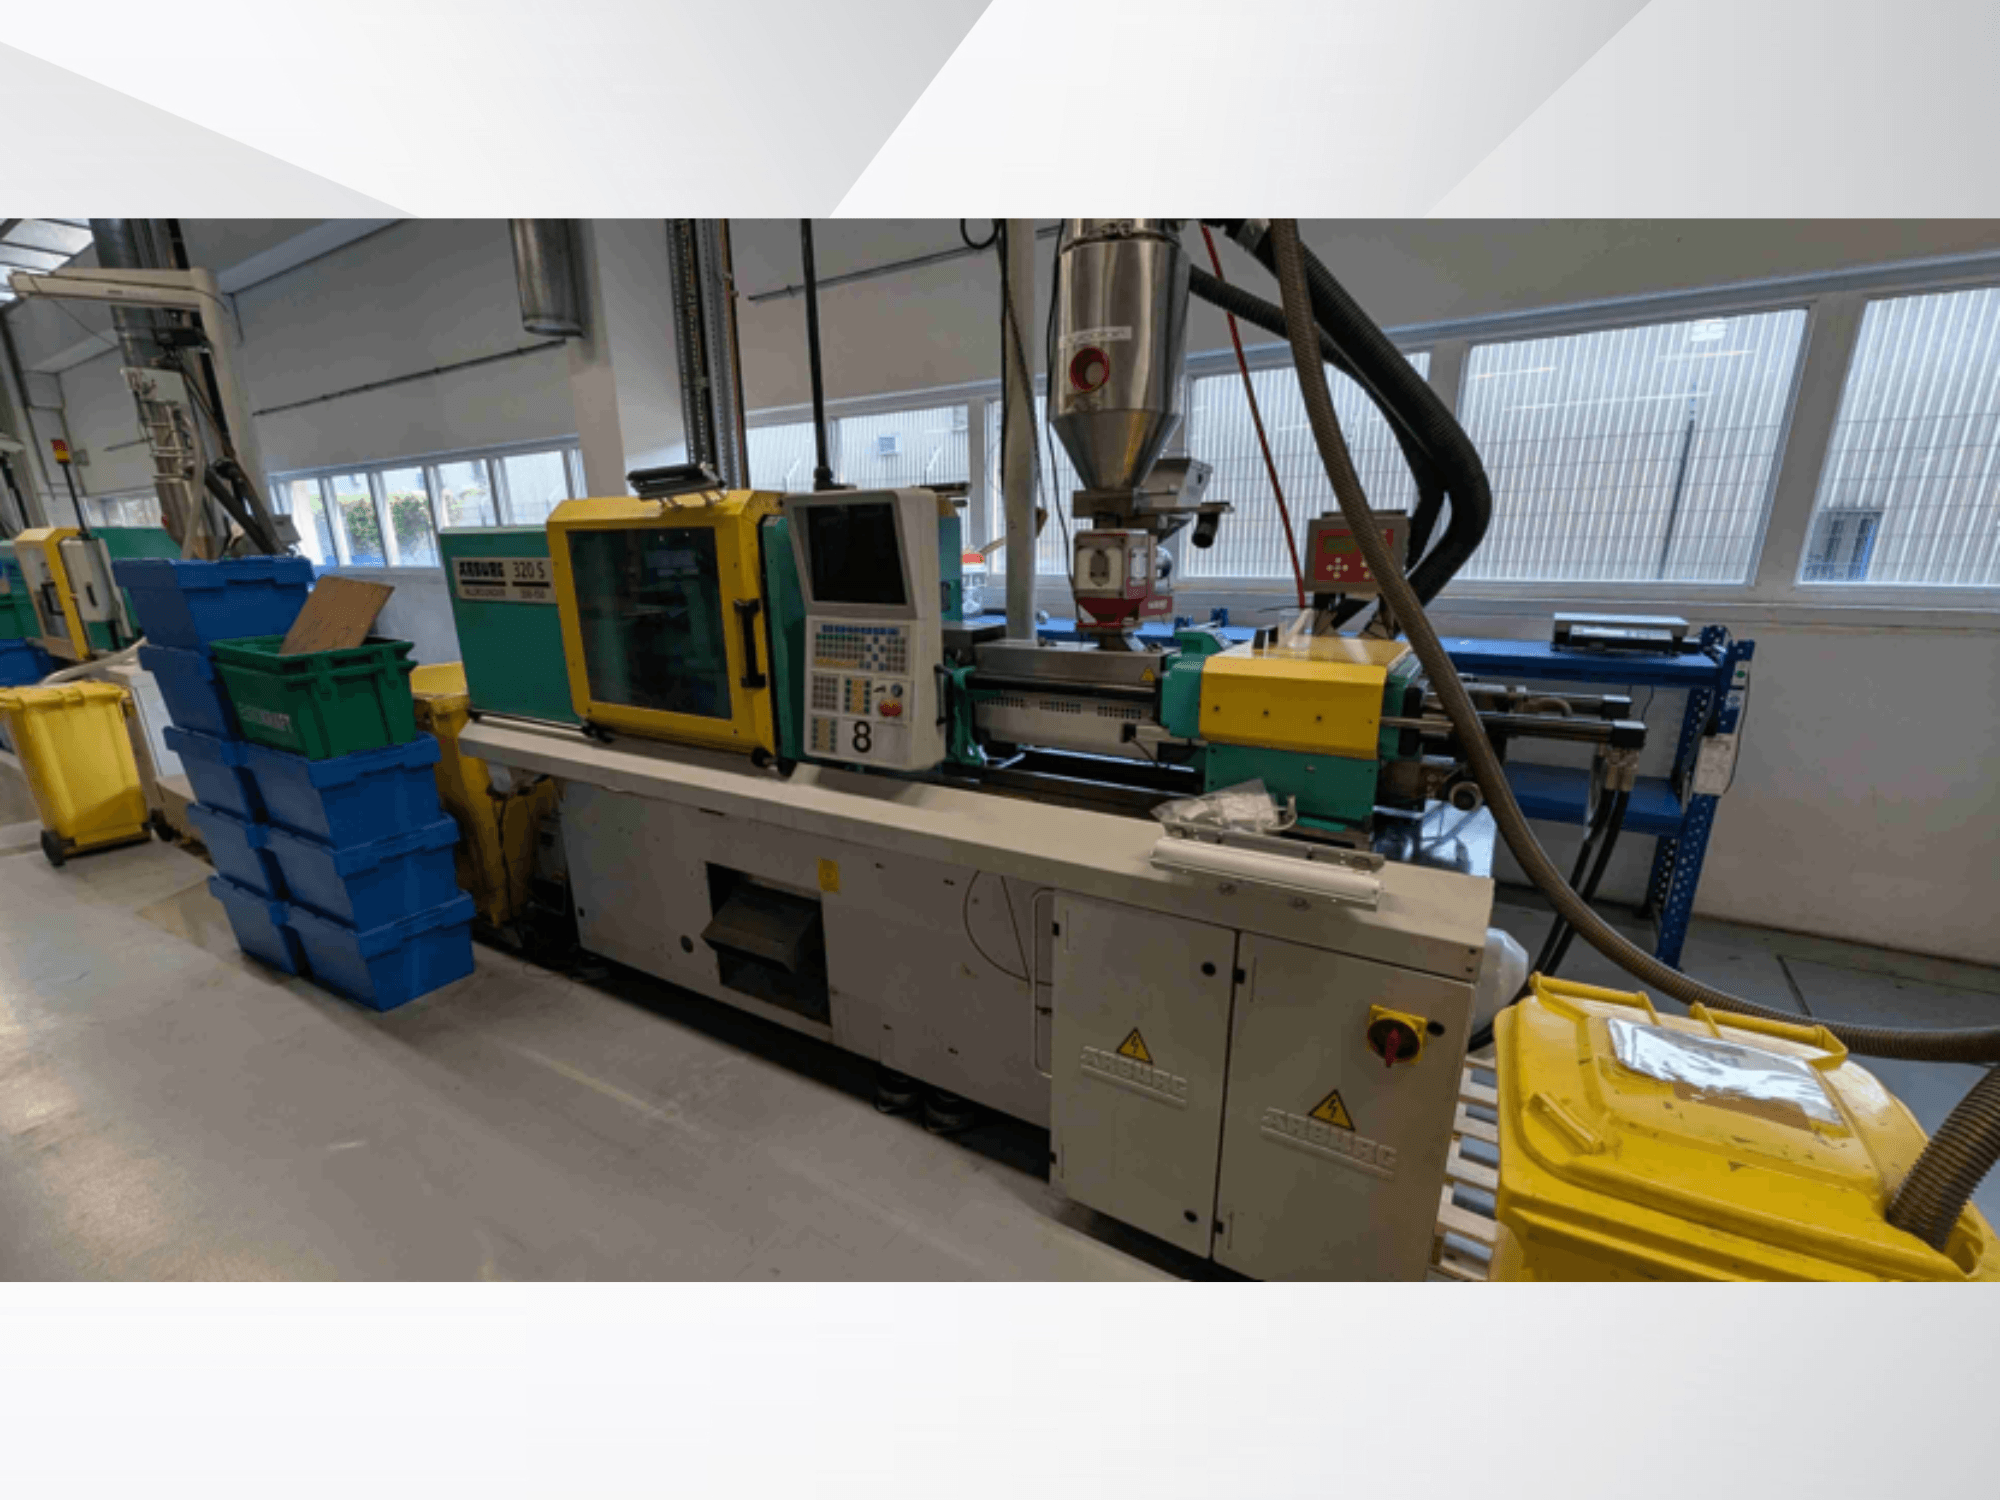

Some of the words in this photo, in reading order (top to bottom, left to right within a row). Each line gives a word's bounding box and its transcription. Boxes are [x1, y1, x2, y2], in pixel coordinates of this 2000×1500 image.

[512, 561, 536, 578] 320
[536, 561, 546, 579] S
[852, 720, 872, 753] 8
[1080, 1045, 1187, 1098] ARBURG
[1261, 1106, 1397, 1168] ARBURG
